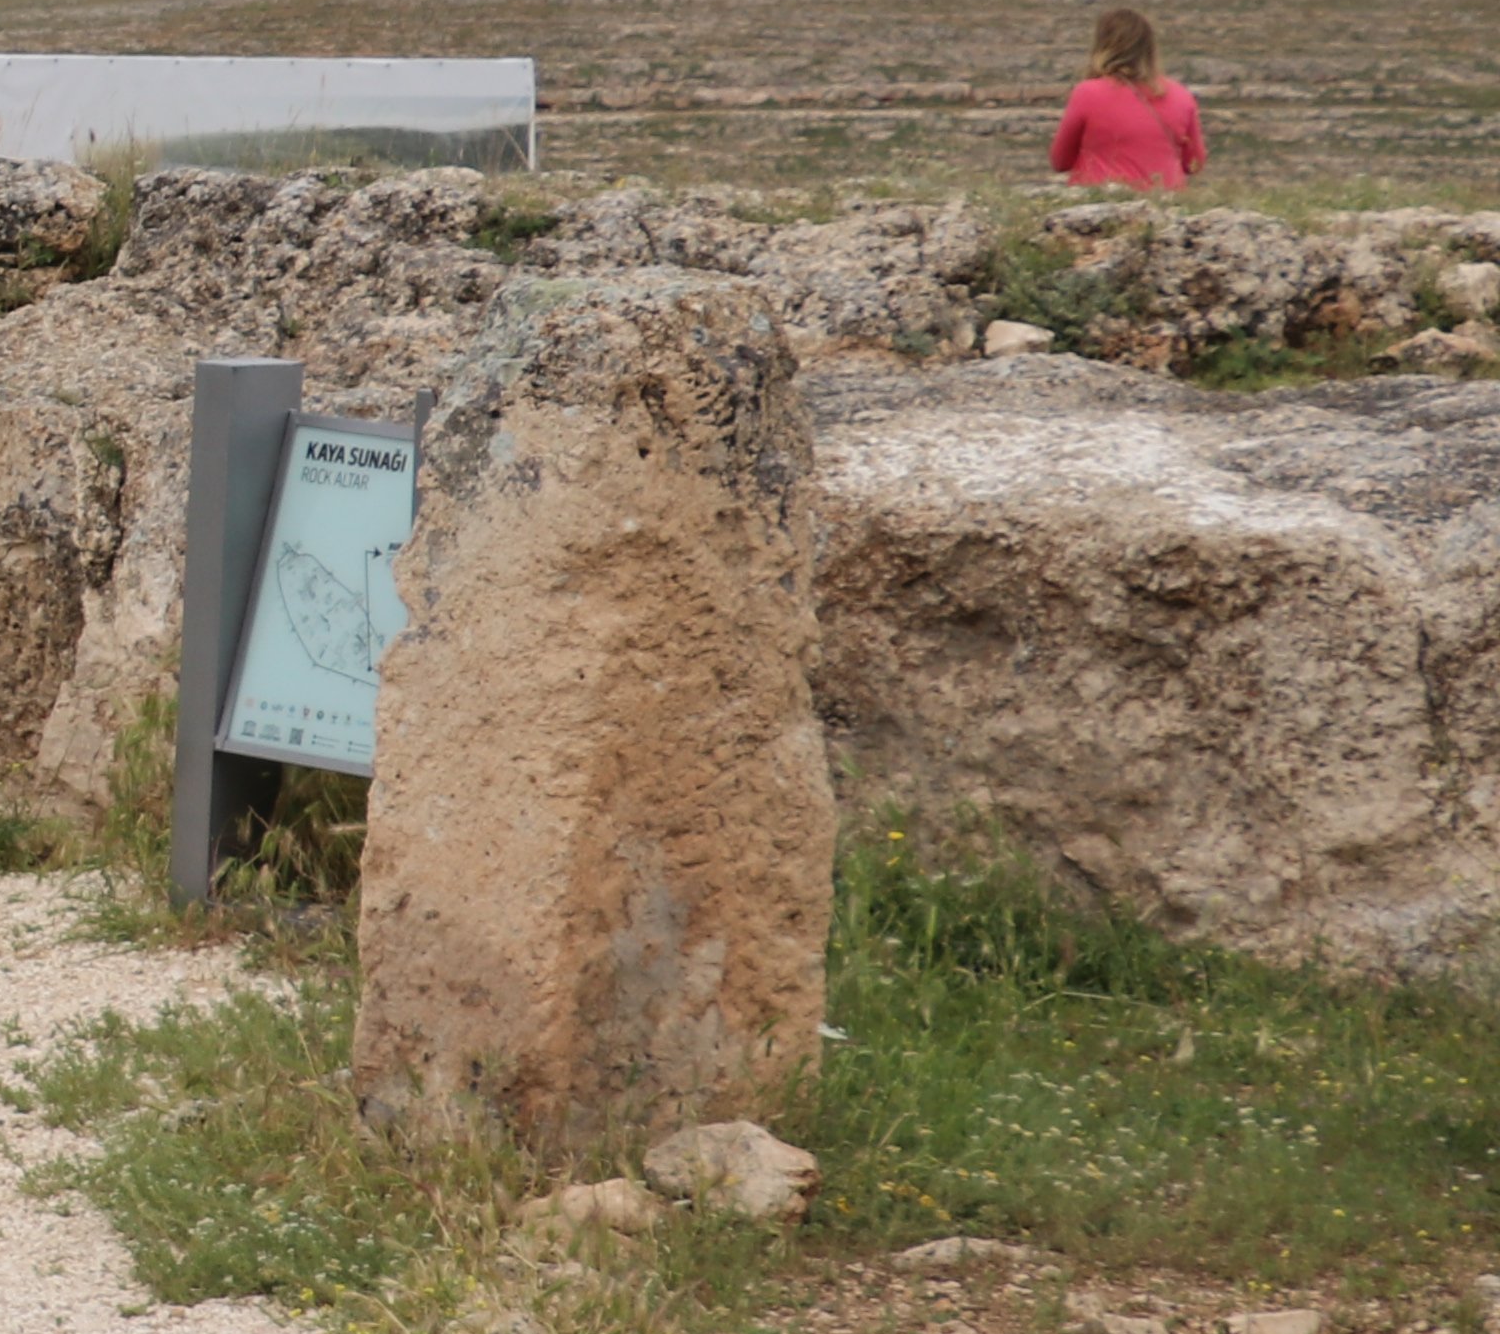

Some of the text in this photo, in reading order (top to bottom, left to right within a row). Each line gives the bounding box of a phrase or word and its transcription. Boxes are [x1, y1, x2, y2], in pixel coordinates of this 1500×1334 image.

[306, 441, 408, 473] KAYA SUNAĞI
[301, 466, 370, 490] ROCK ALTAR
